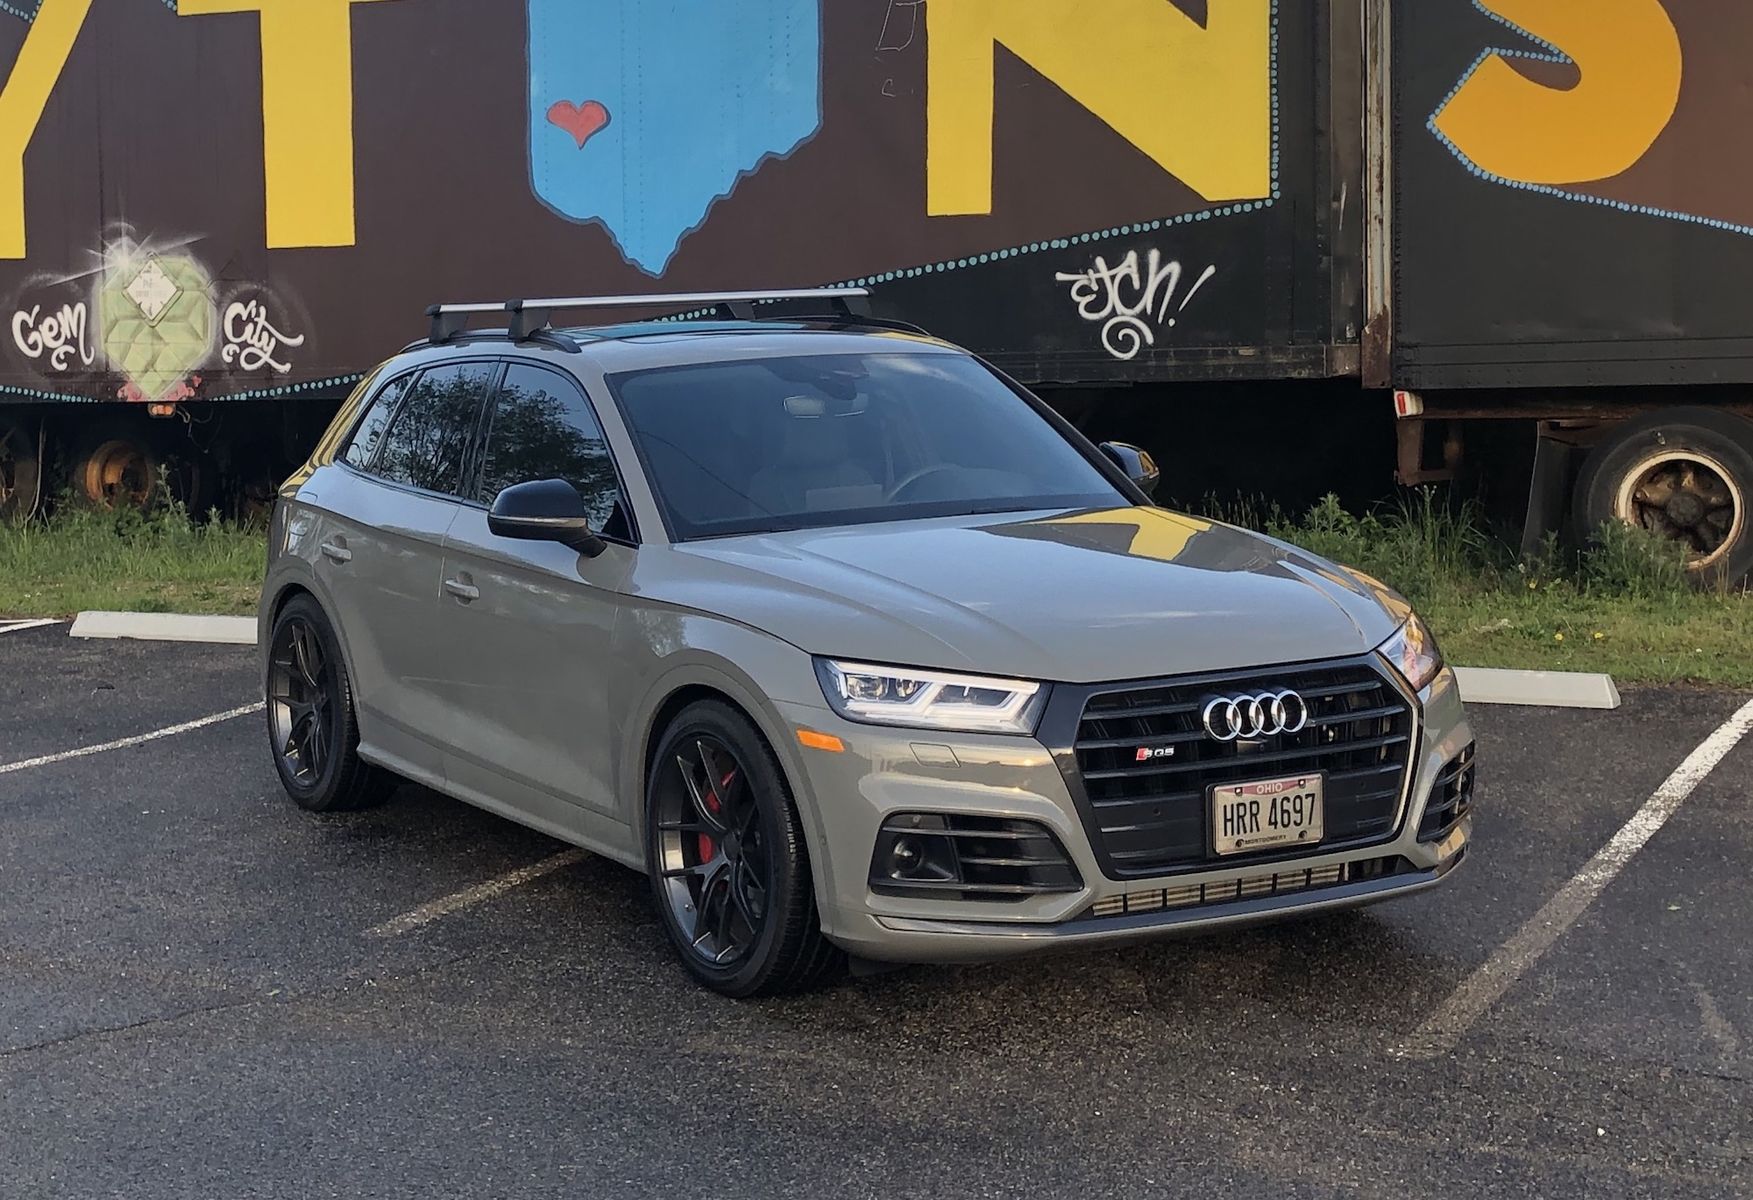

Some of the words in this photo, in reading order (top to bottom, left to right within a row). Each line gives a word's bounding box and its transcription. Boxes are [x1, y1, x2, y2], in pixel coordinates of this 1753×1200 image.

[1256, 782, 1283, 794] OHIO
[1223, 800, 1261, 837] HRR
[1268, 793, 1316, 830] 4697
